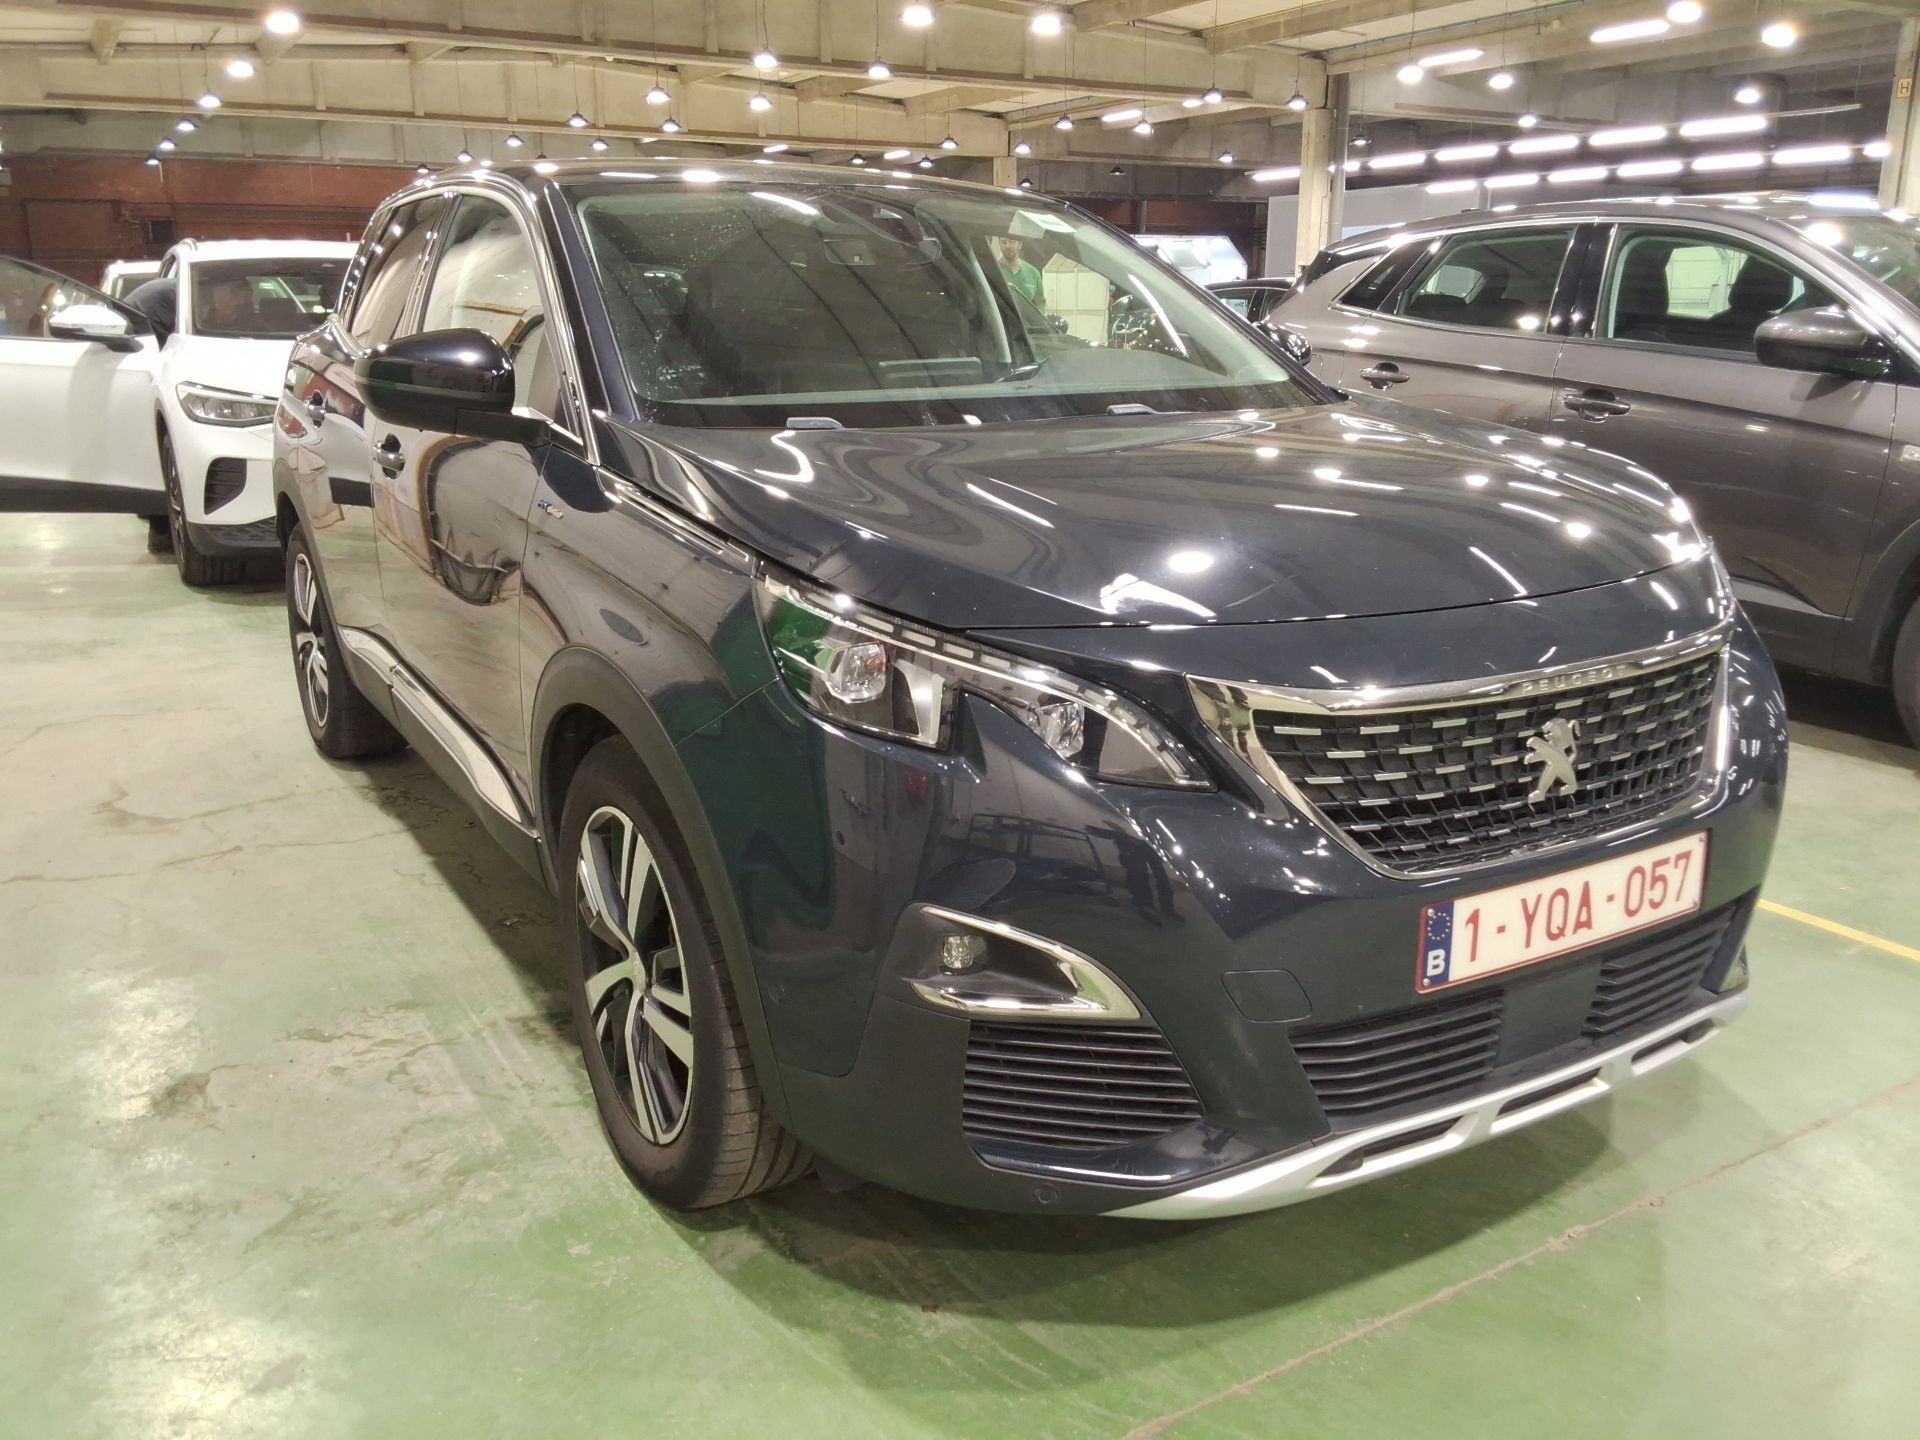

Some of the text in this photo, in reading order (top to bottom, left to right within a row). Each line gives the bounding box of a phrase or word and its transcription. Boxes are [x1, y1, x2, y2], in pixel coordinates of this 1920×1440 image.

[1900, 81, 1910, 94] H
[1521, 665, 1627, 695] PEUGEOT
[1465, 850, 1693, 962] 1-YQA-057
[1426, 948, 1446, 977] B
